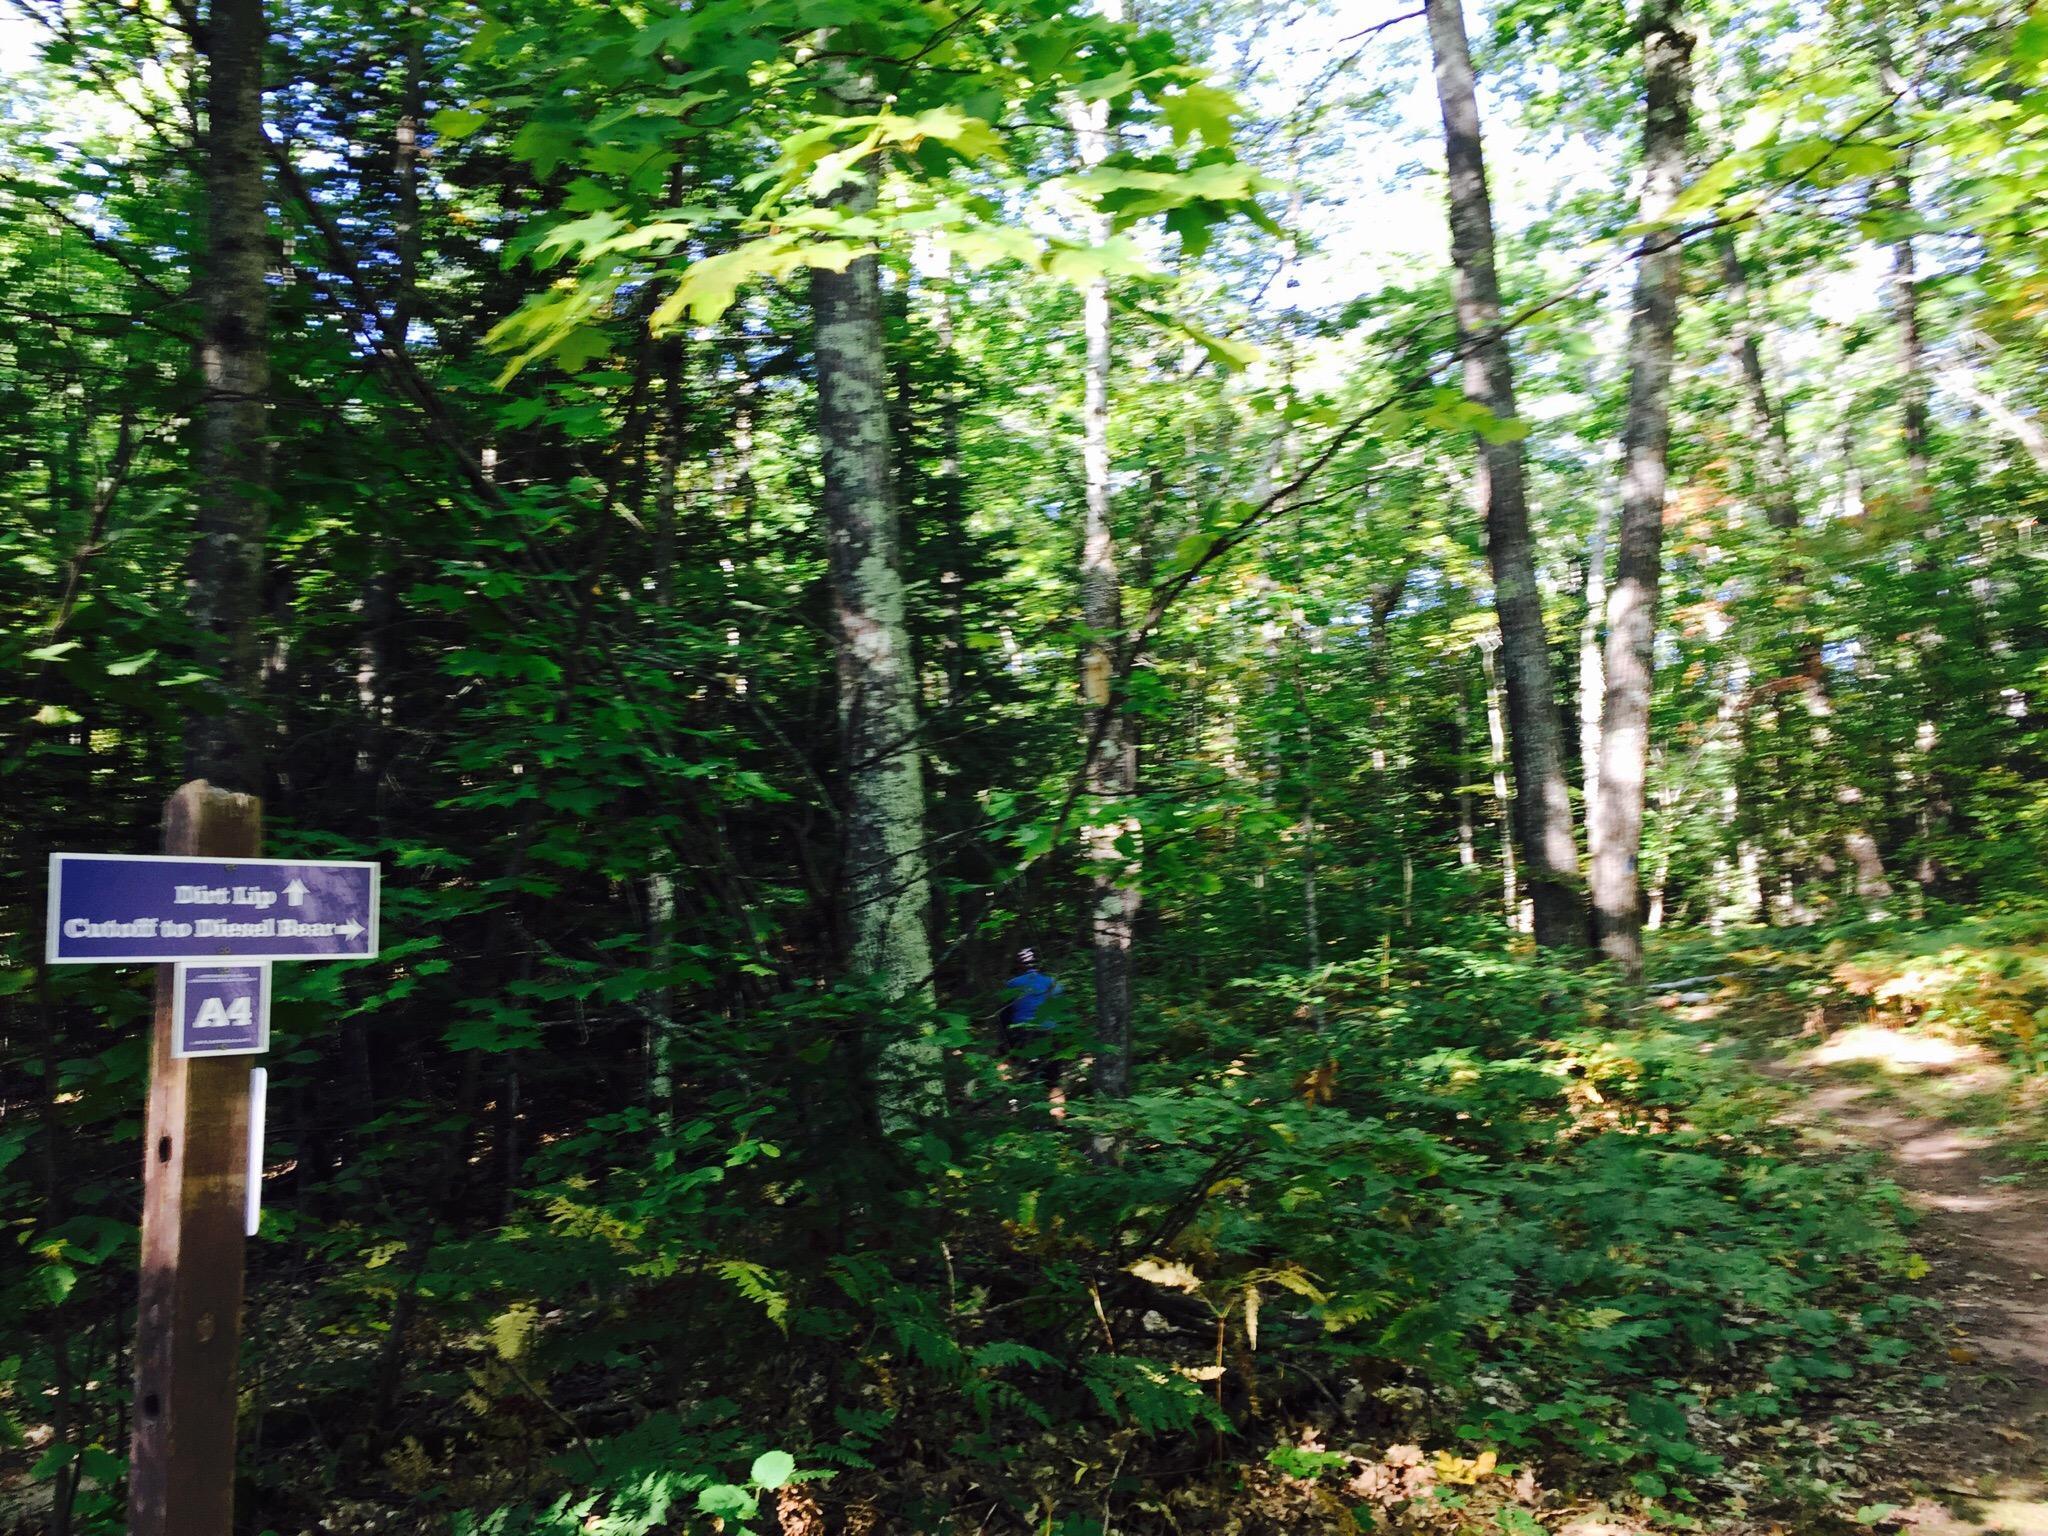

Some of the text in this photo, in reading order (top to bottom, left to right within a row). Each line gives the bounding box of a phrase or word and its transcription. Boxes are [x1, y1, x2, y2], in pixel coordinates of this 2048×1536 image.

[231, 886, 277, 909] Lip
[63, 918, 335, 938] Cutoff to Diesel Bear
[192, 996, 252, 1028] A4
